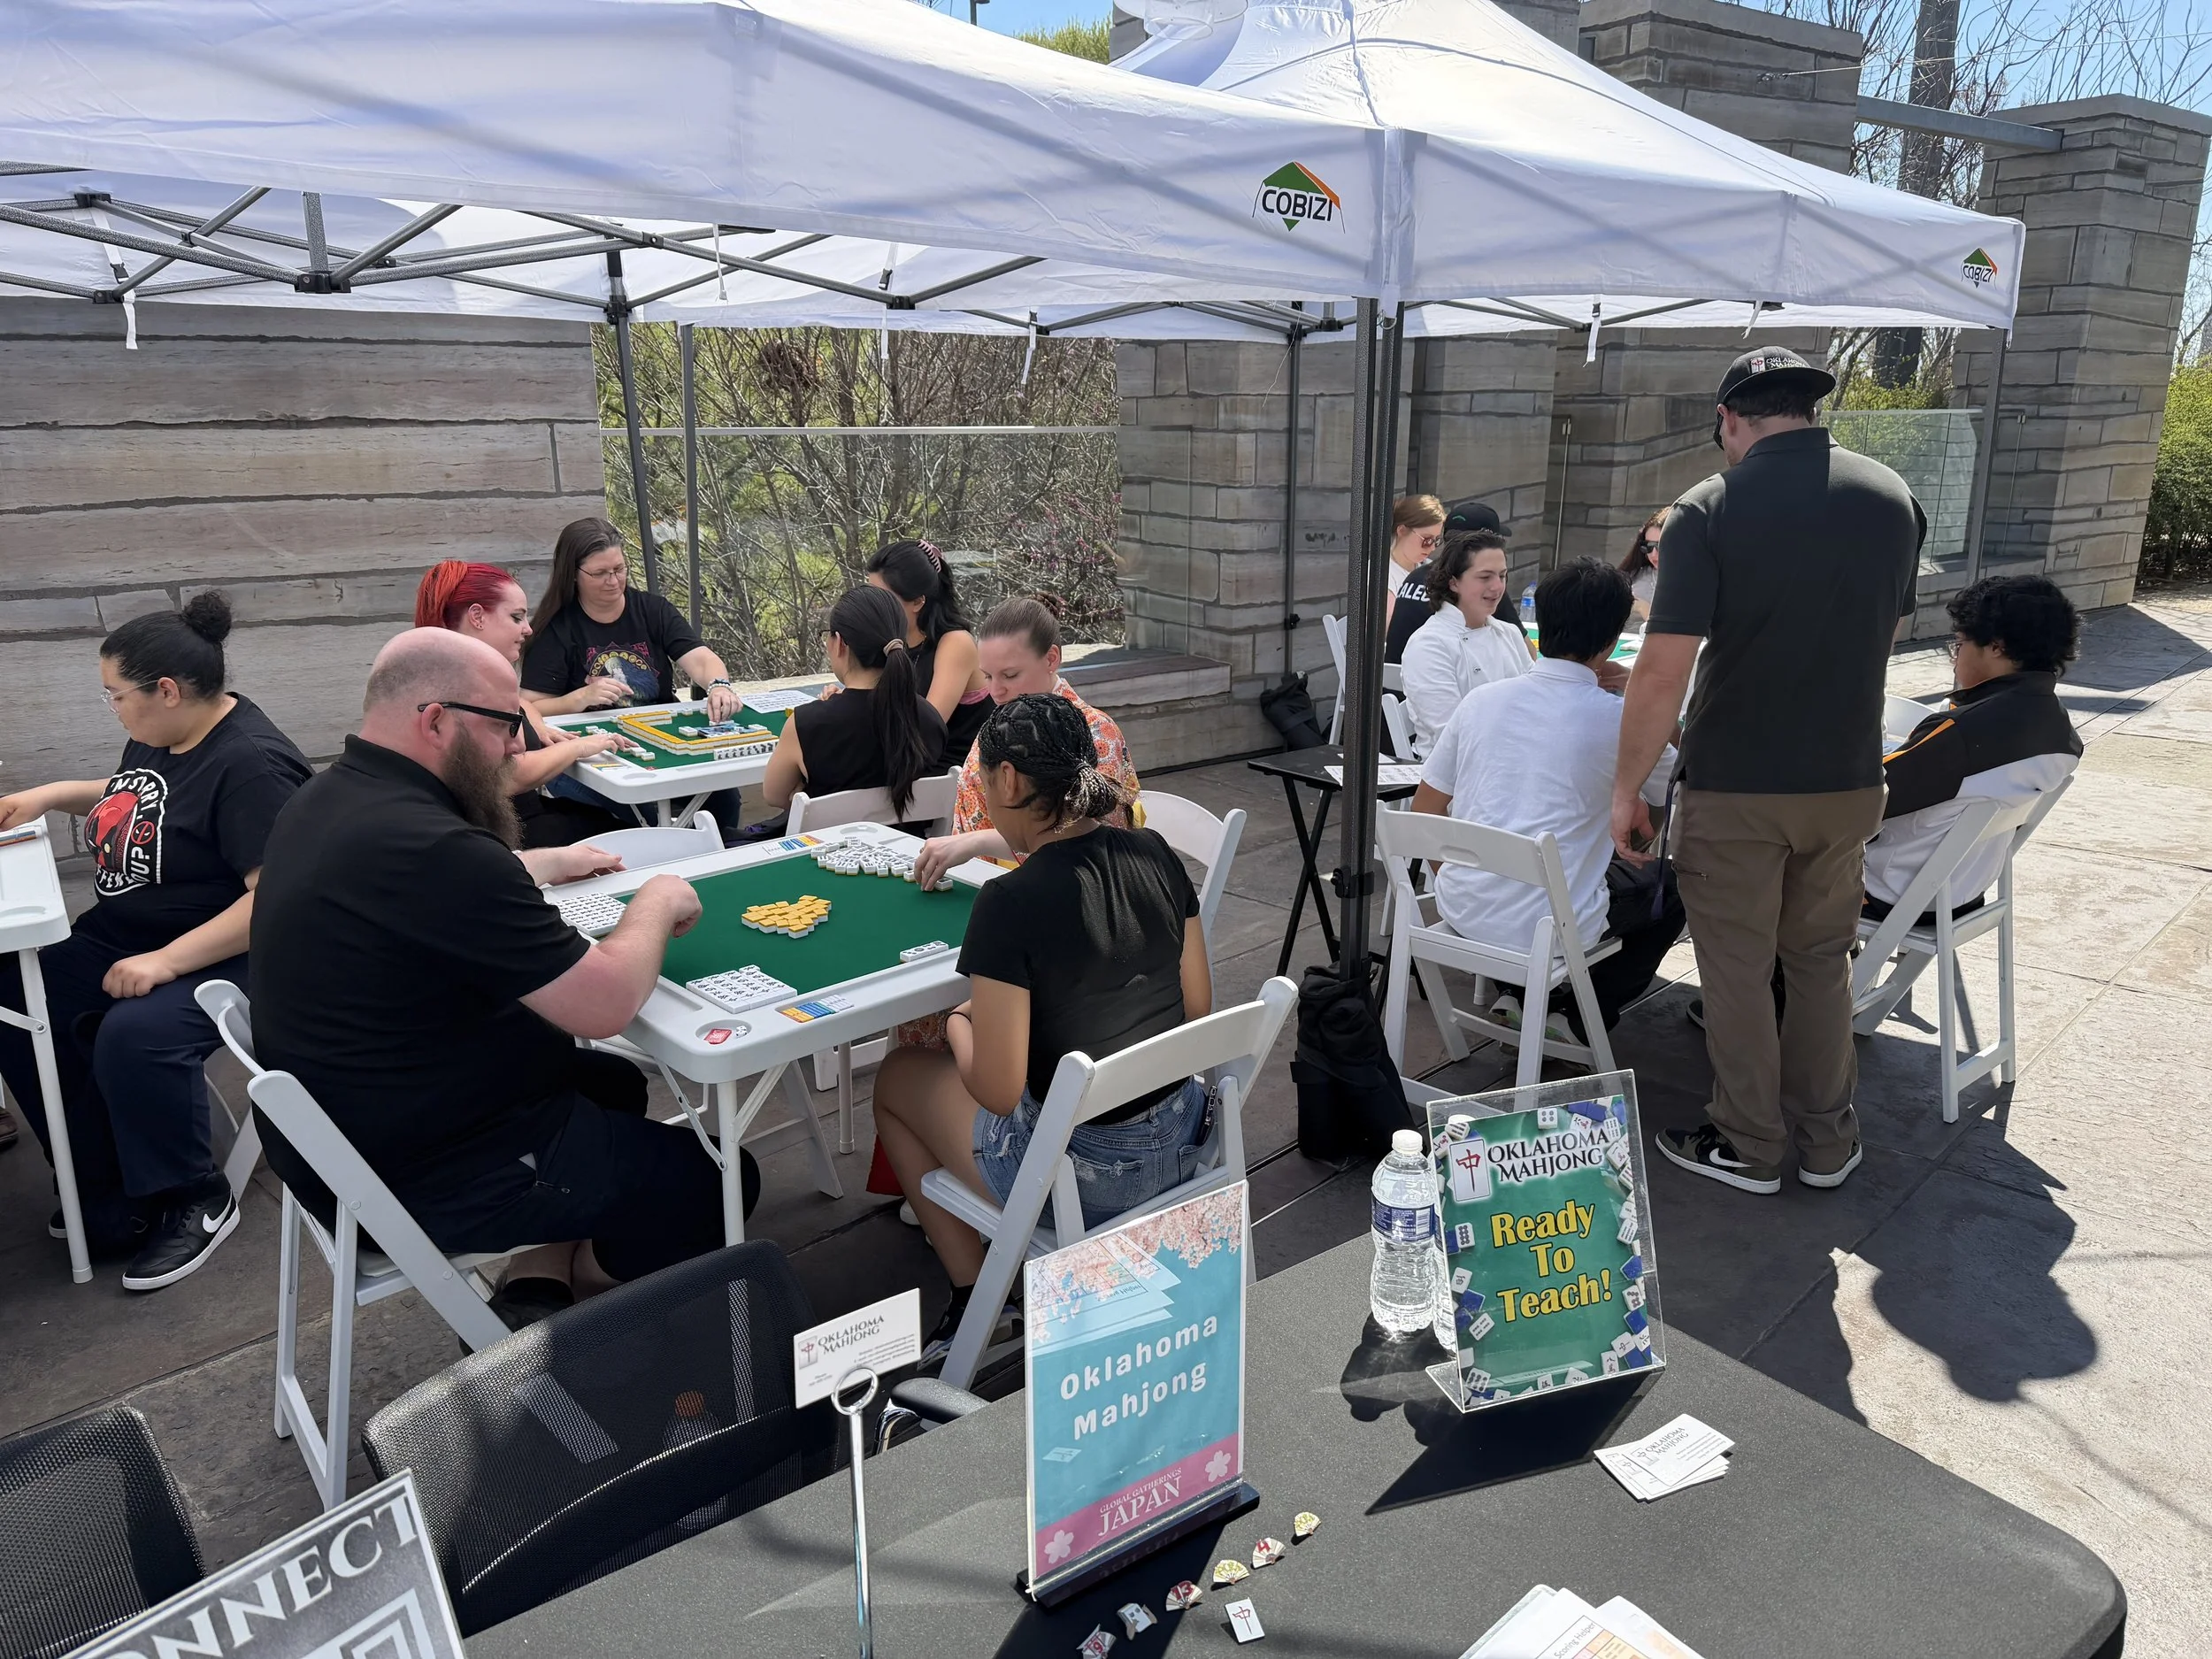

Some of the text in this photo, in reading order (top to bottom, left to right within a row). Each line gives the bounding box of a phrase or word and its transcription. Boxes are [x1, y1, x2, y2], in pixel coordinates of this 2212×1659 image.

[1262, 188, 1333, 221] COBIZI
[1962, 265, 1994, 282] COBIZI
[1487, 1128, 1609, 1163] OKLAHOMA
[1496, 1148, 1603, 1182] MAHJONG
[1490, 1199, 1595, 1248] Ready
[1529, 1242, 1575, 1278] To
[1496, 1268, 1612, 1323] Teach!
[818, 1315, 885, 1347] OKLAHOMA
[823, 1325, 879, 1355] MAHJONG
[1060, 1316, 1217, 1400] Oklahoma
[1073, 1362, 1207, 1440] Mahjong
[1645, 1427, 1686, 1453] OKLAHOMA
[1654, 1432, 1689, 1455] MAHJONG
[1098, 1475, 1182, 1537] JAPAN
[1100, 1467, 1182, 1513] GLOBAL GATHERINGS
[104, 1493, 419, 1659] NNECT
[1554, 1622, 1596, 1659] Scoring Helper
